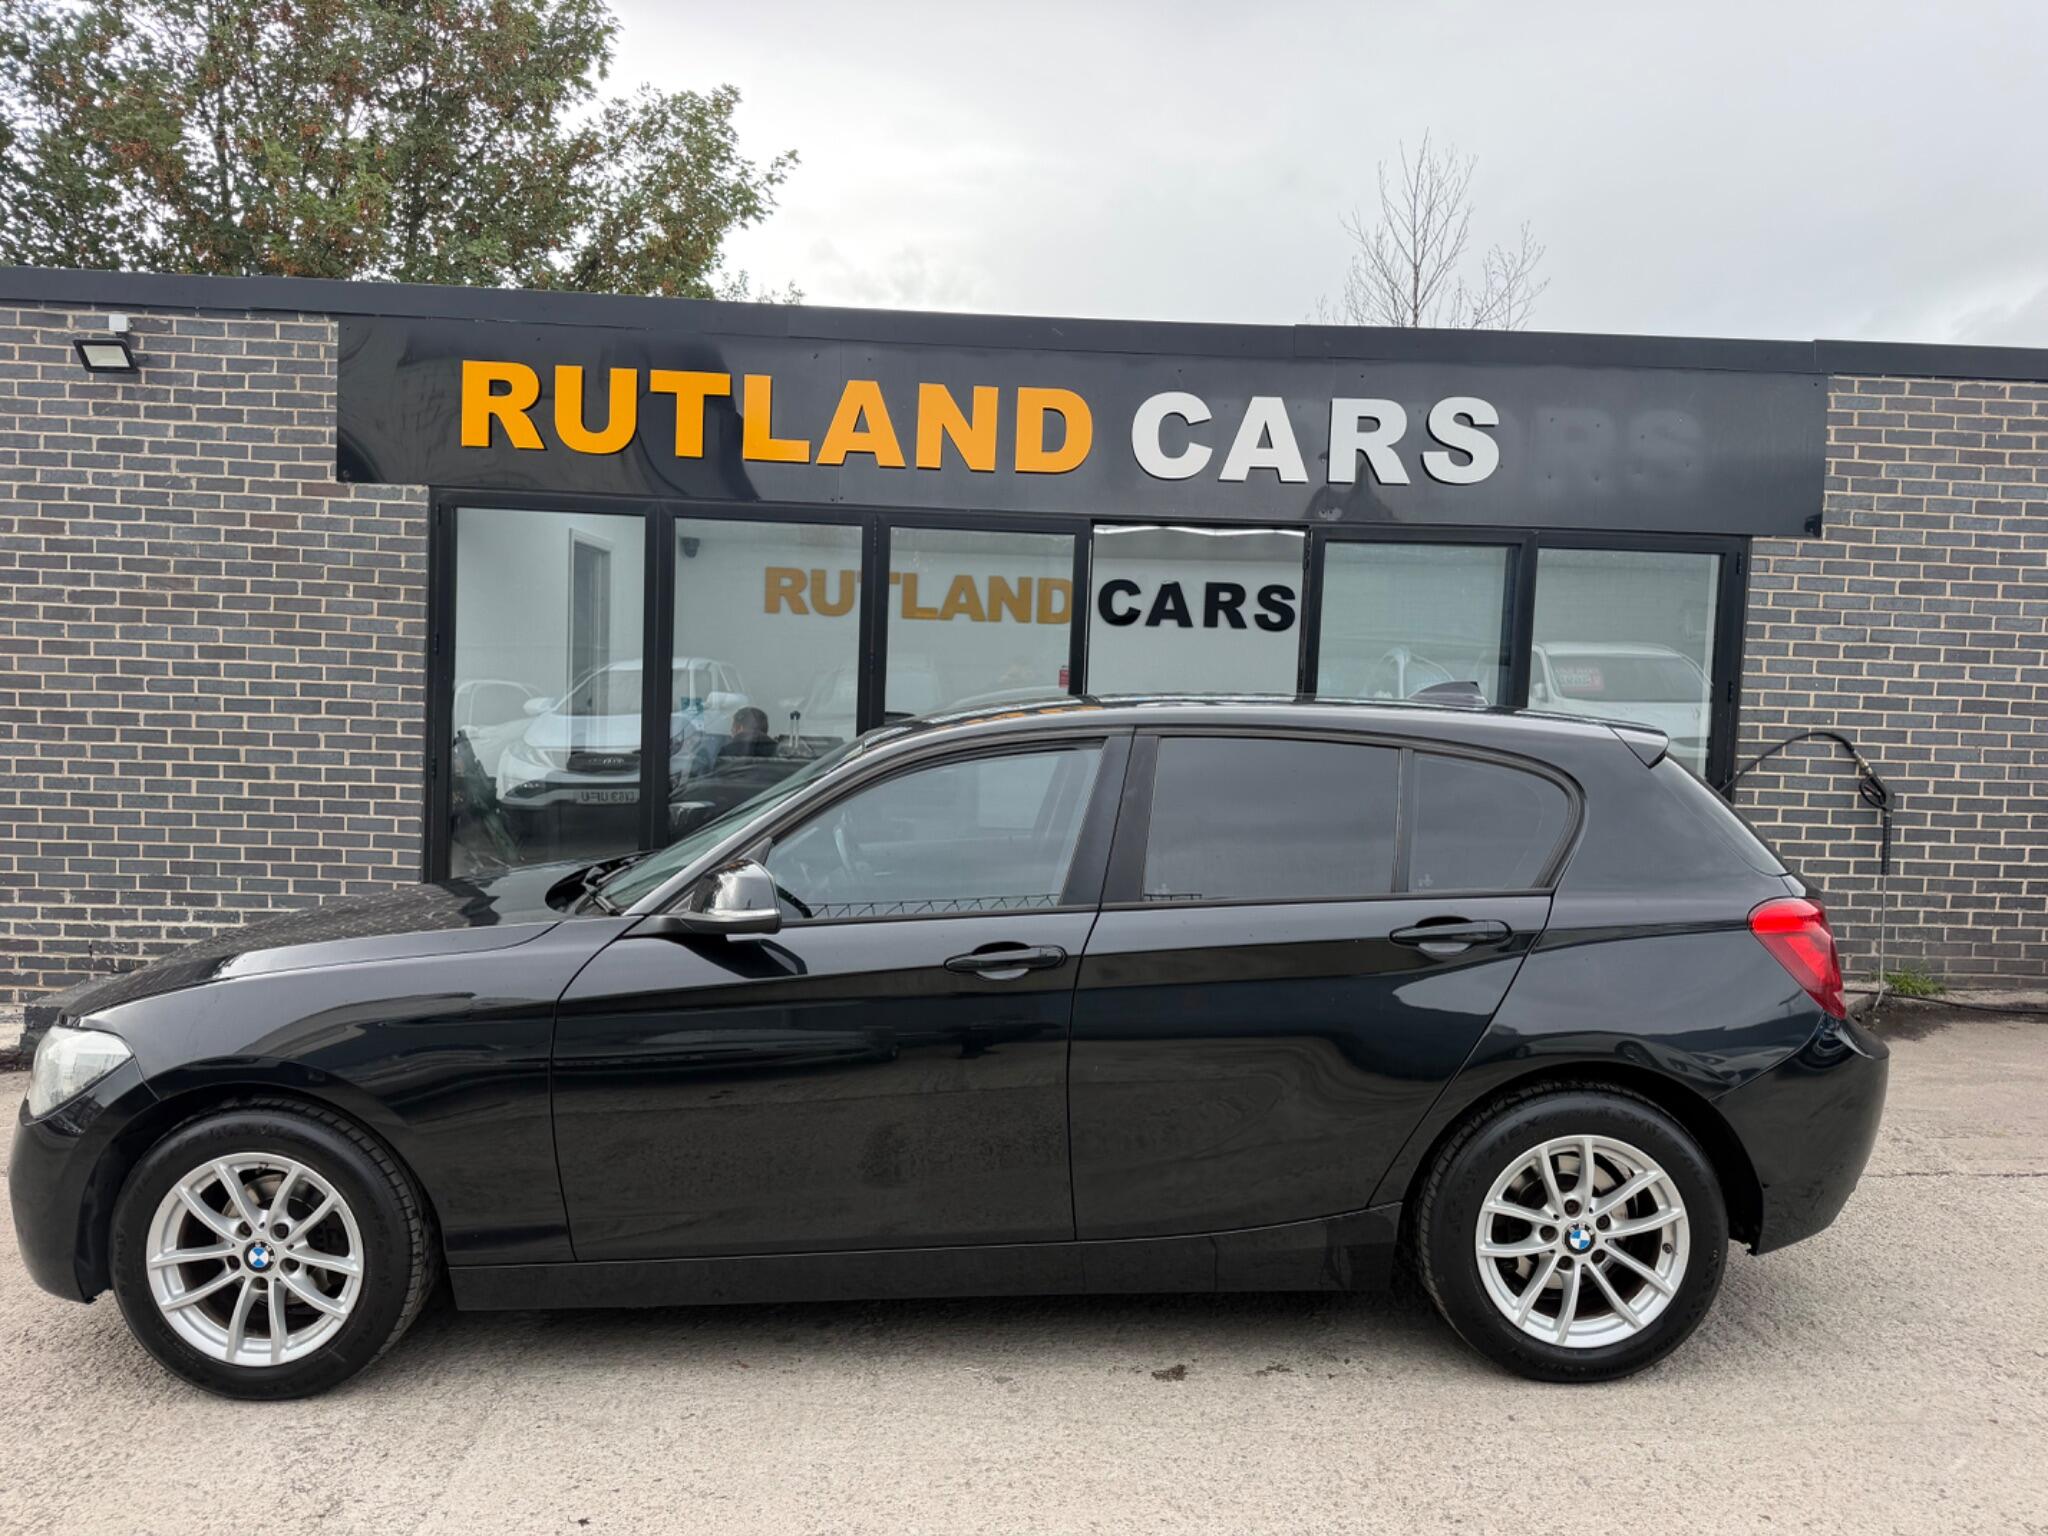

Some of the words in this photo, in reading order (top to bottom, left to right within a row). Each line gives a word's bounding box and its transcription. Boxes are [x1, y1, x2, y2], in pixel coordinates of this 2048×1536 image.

[460, 360, 1093, 474] RUTLAND
[1131, 391, 1500, 484] CARS
[765, 567, 1073, 625] RULAND
[1097, 578, 1297, 632] CARS
